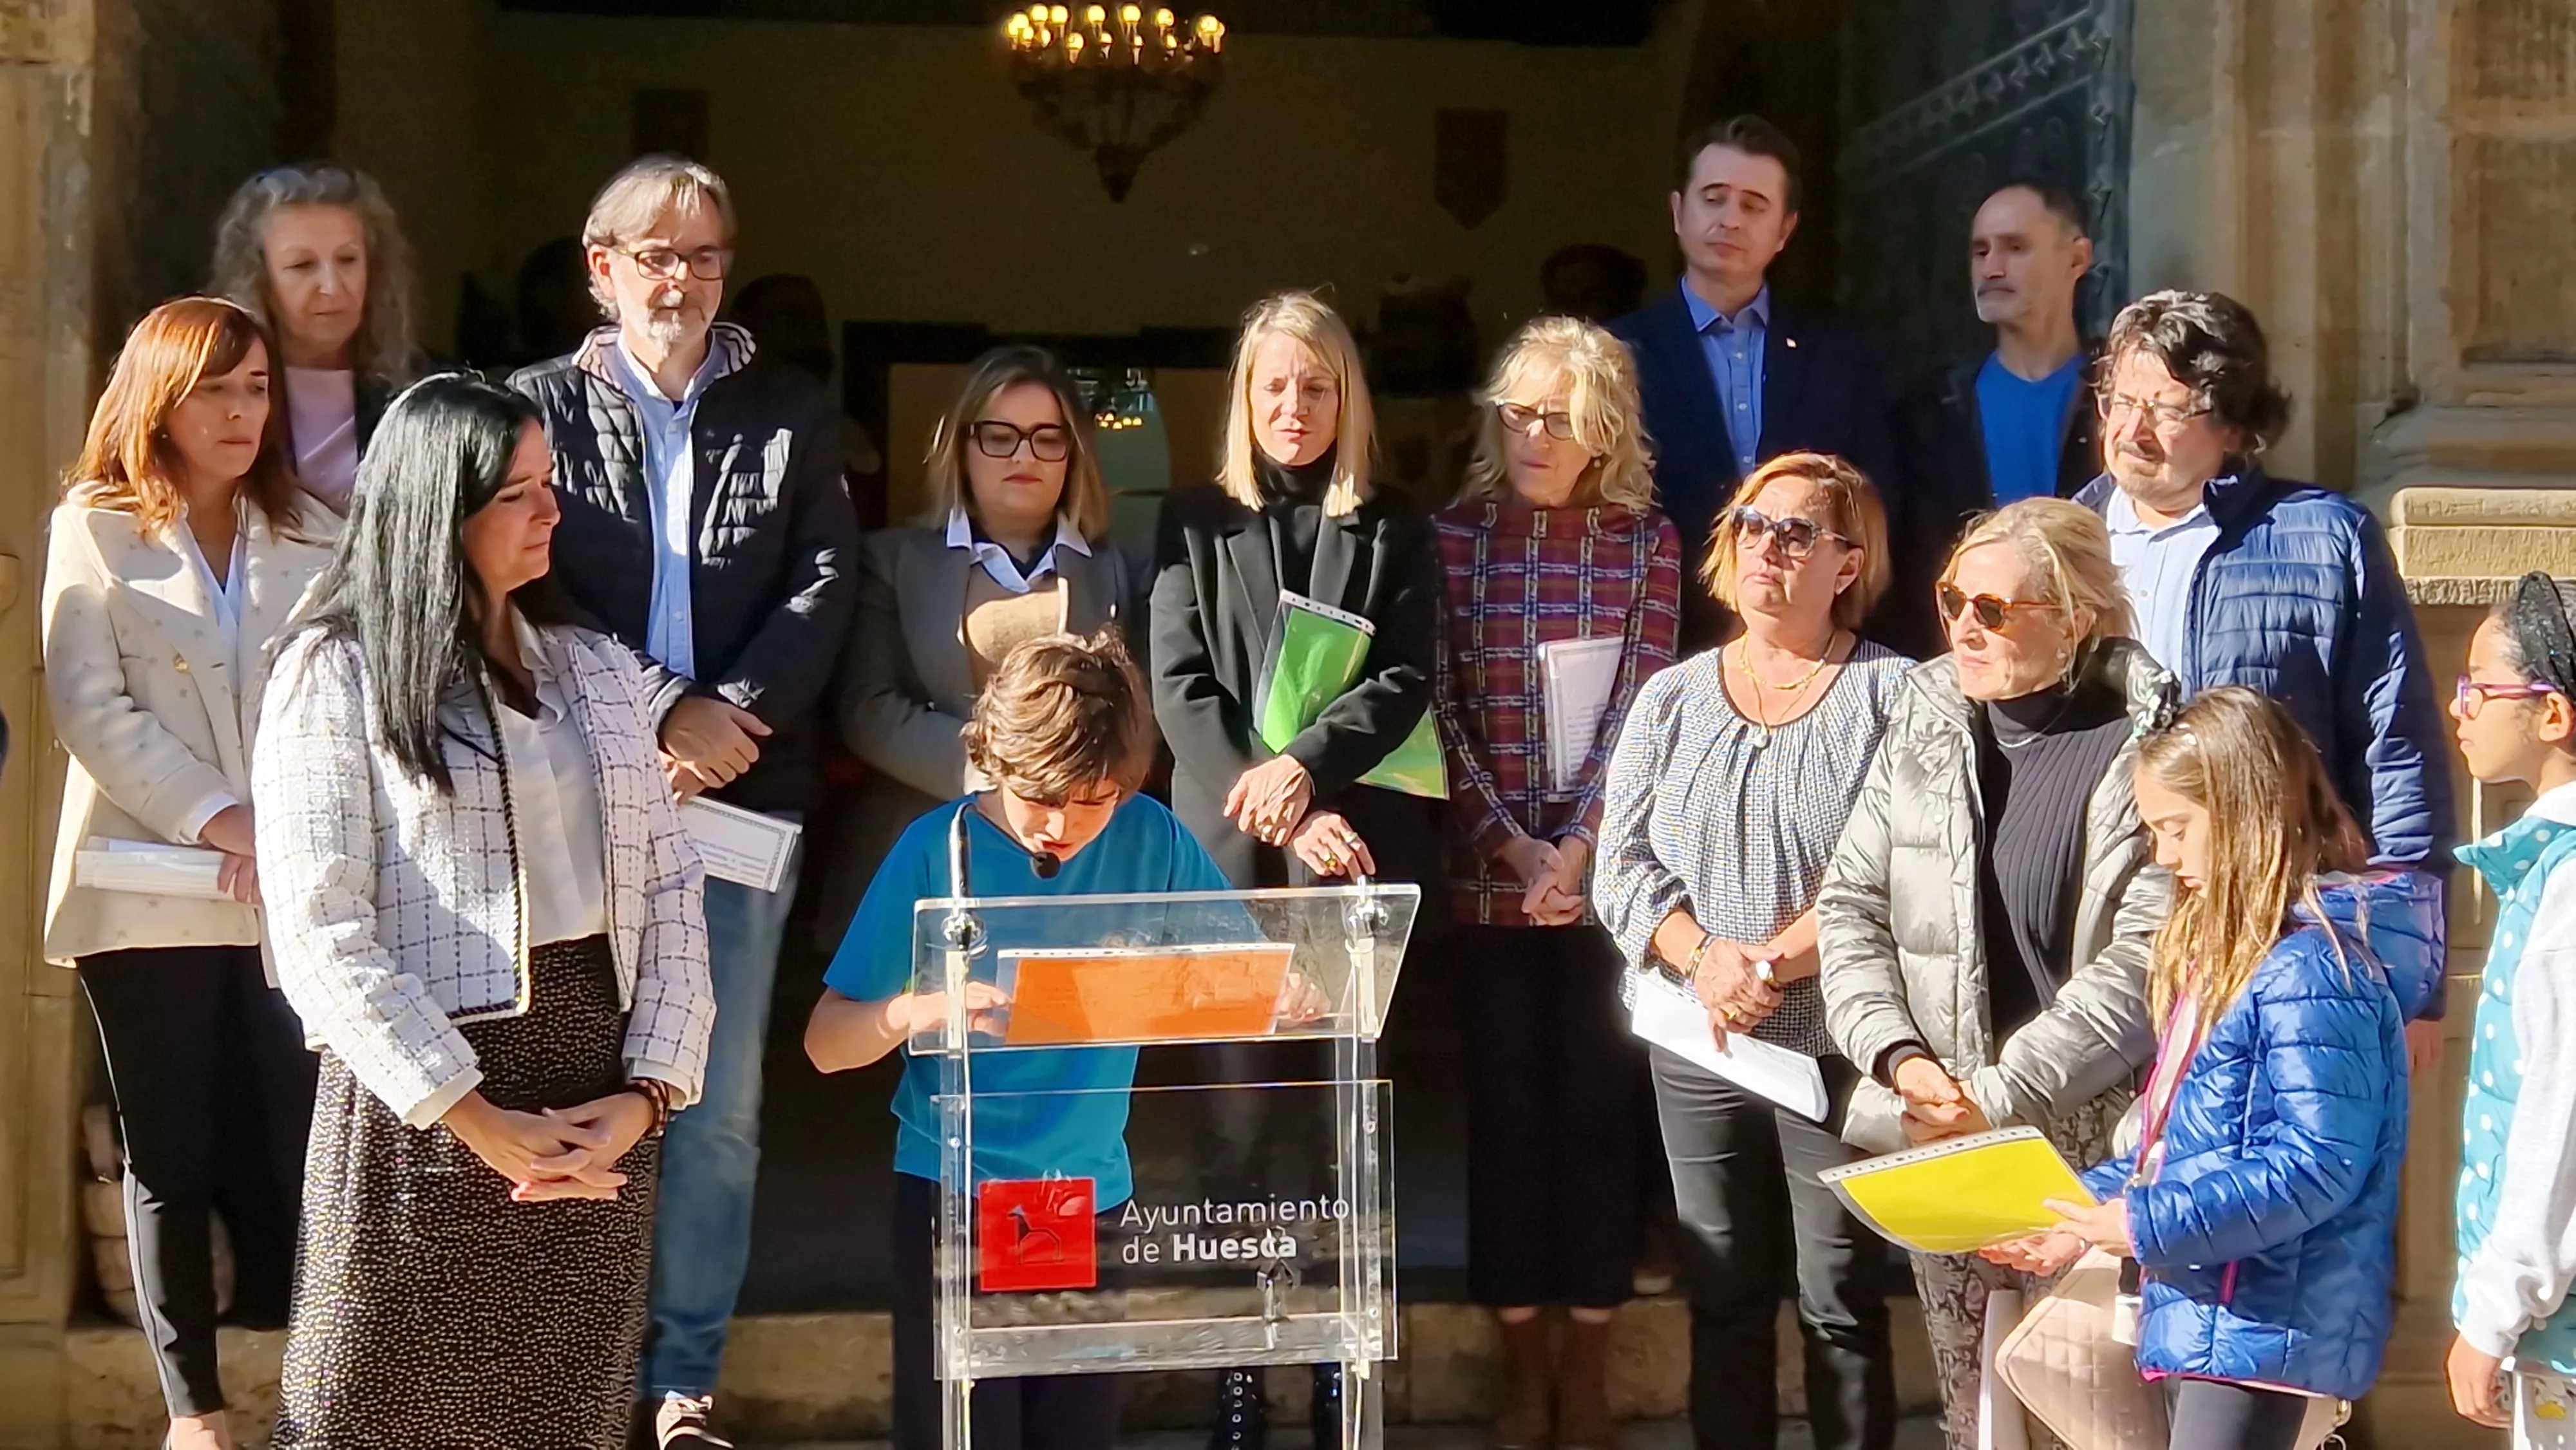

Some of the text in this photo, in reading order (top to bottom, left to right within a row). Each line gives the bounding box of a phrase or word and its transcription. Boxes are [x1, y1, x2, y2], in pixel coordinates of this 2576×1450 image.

[1120, 1193, 1350, 1234] Ayuntamiento
[1122, 1233, 1297, 1264] de Huesca
